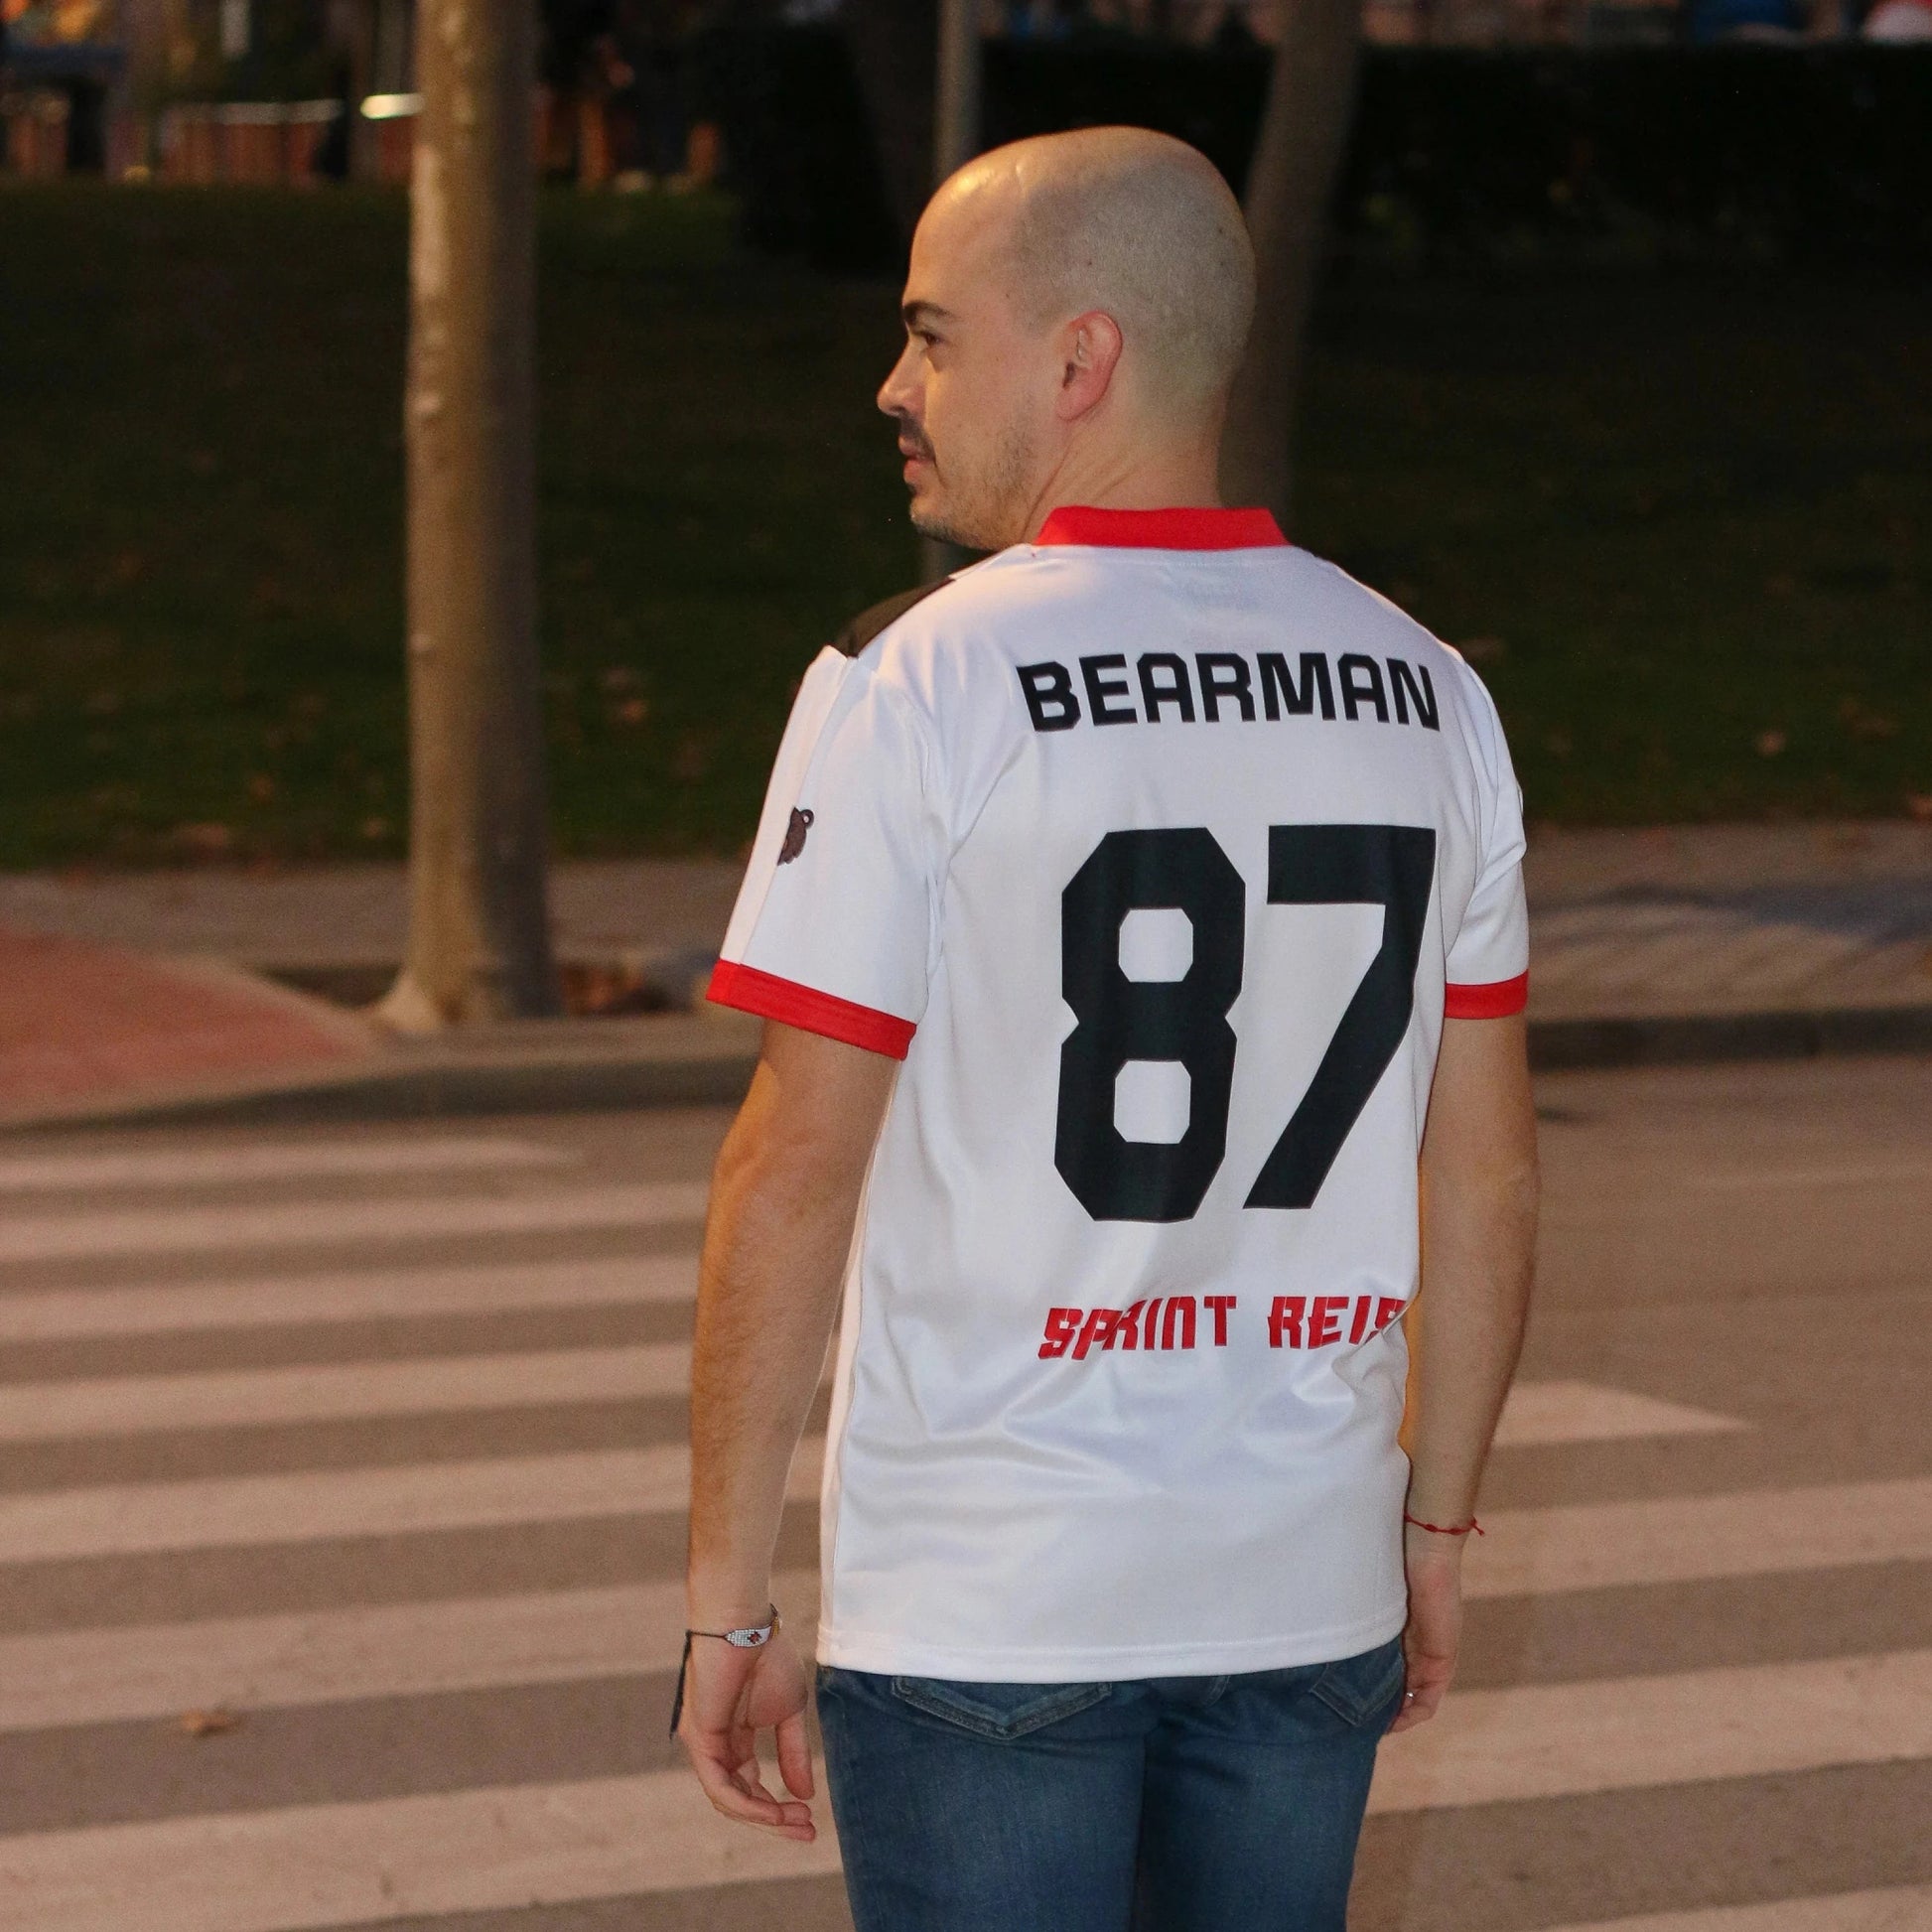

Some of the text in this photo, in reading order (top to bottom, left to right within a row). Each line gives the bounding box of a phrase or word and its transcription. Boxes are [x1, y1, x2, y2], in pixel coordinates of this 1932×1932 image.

[1016, 651, 1441, 733] BEARMAN
[1053, 823, 1437, 1224] 87
[1037, 1295, 1237, 1360] SPRINT
